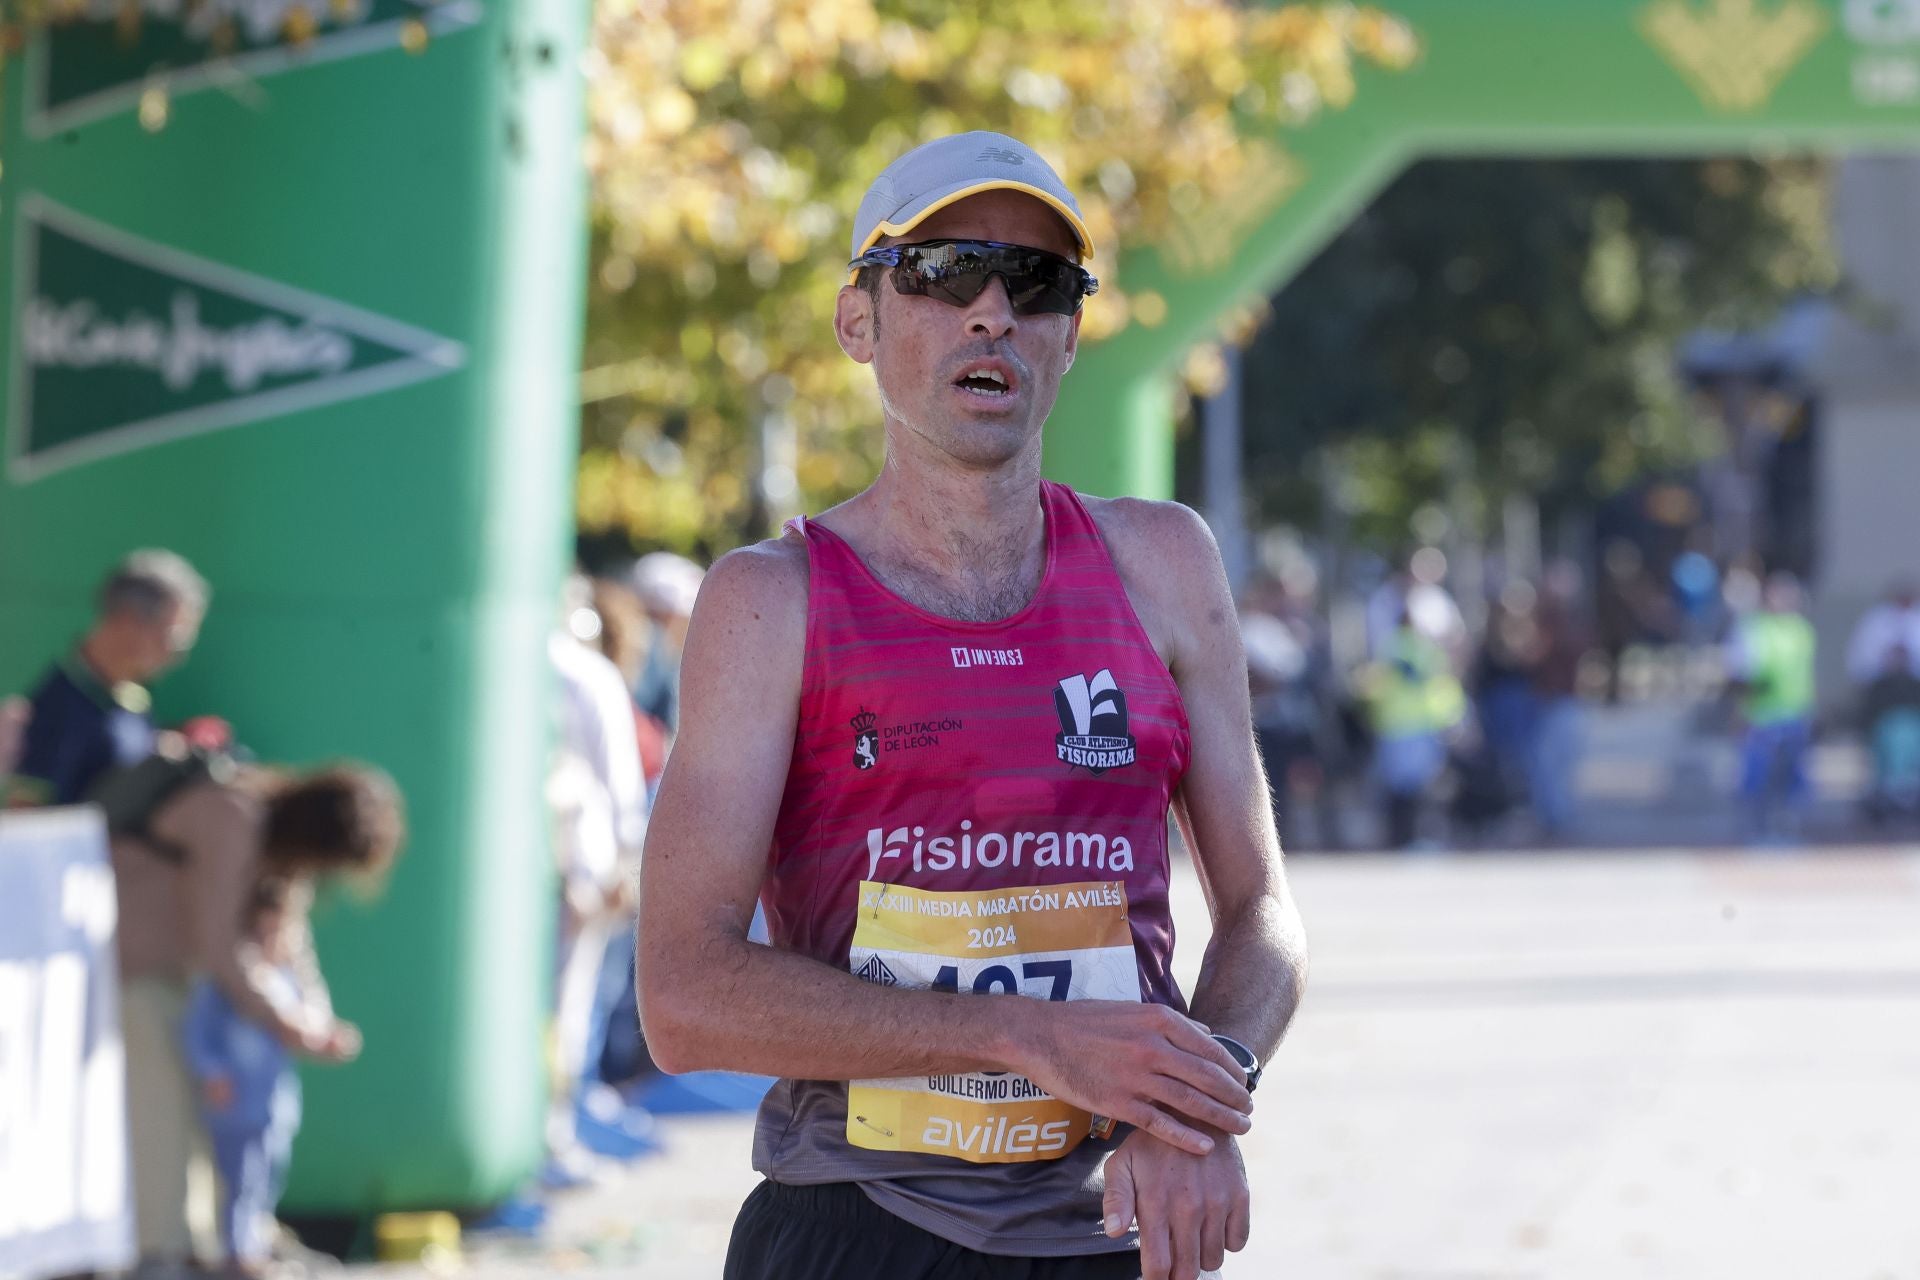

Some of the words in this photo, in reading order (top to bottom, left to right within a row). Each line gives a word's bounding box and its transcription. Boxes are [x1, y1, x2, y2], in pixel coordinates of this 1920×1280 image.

[970, 648, 1024, 666] INVERSE
[884, 717, 963, 739] DIPUTACIÓN
[885, 740, 900, 752] DE
[904, 734, 939, 750] LEÓN
[1067, 737, 1086, 747] CLUB
[1088, 737, 1127, 749] ATLETISMO
[1057, 744, 1135, 768] FISIORAMA
[866, 819, 1134, 881] Fisiorama
[917, 897, 973, 918] MEDIA
[977, 889, 1060, 917] MARATÓN
[1064, 883, 1122, 909] AVILÉS
[967, 924, 1017, 949] 2024
[928, 1074, 1008, 1099] GUILLERMO
[922, 1115, 1071, 1154] avilés
